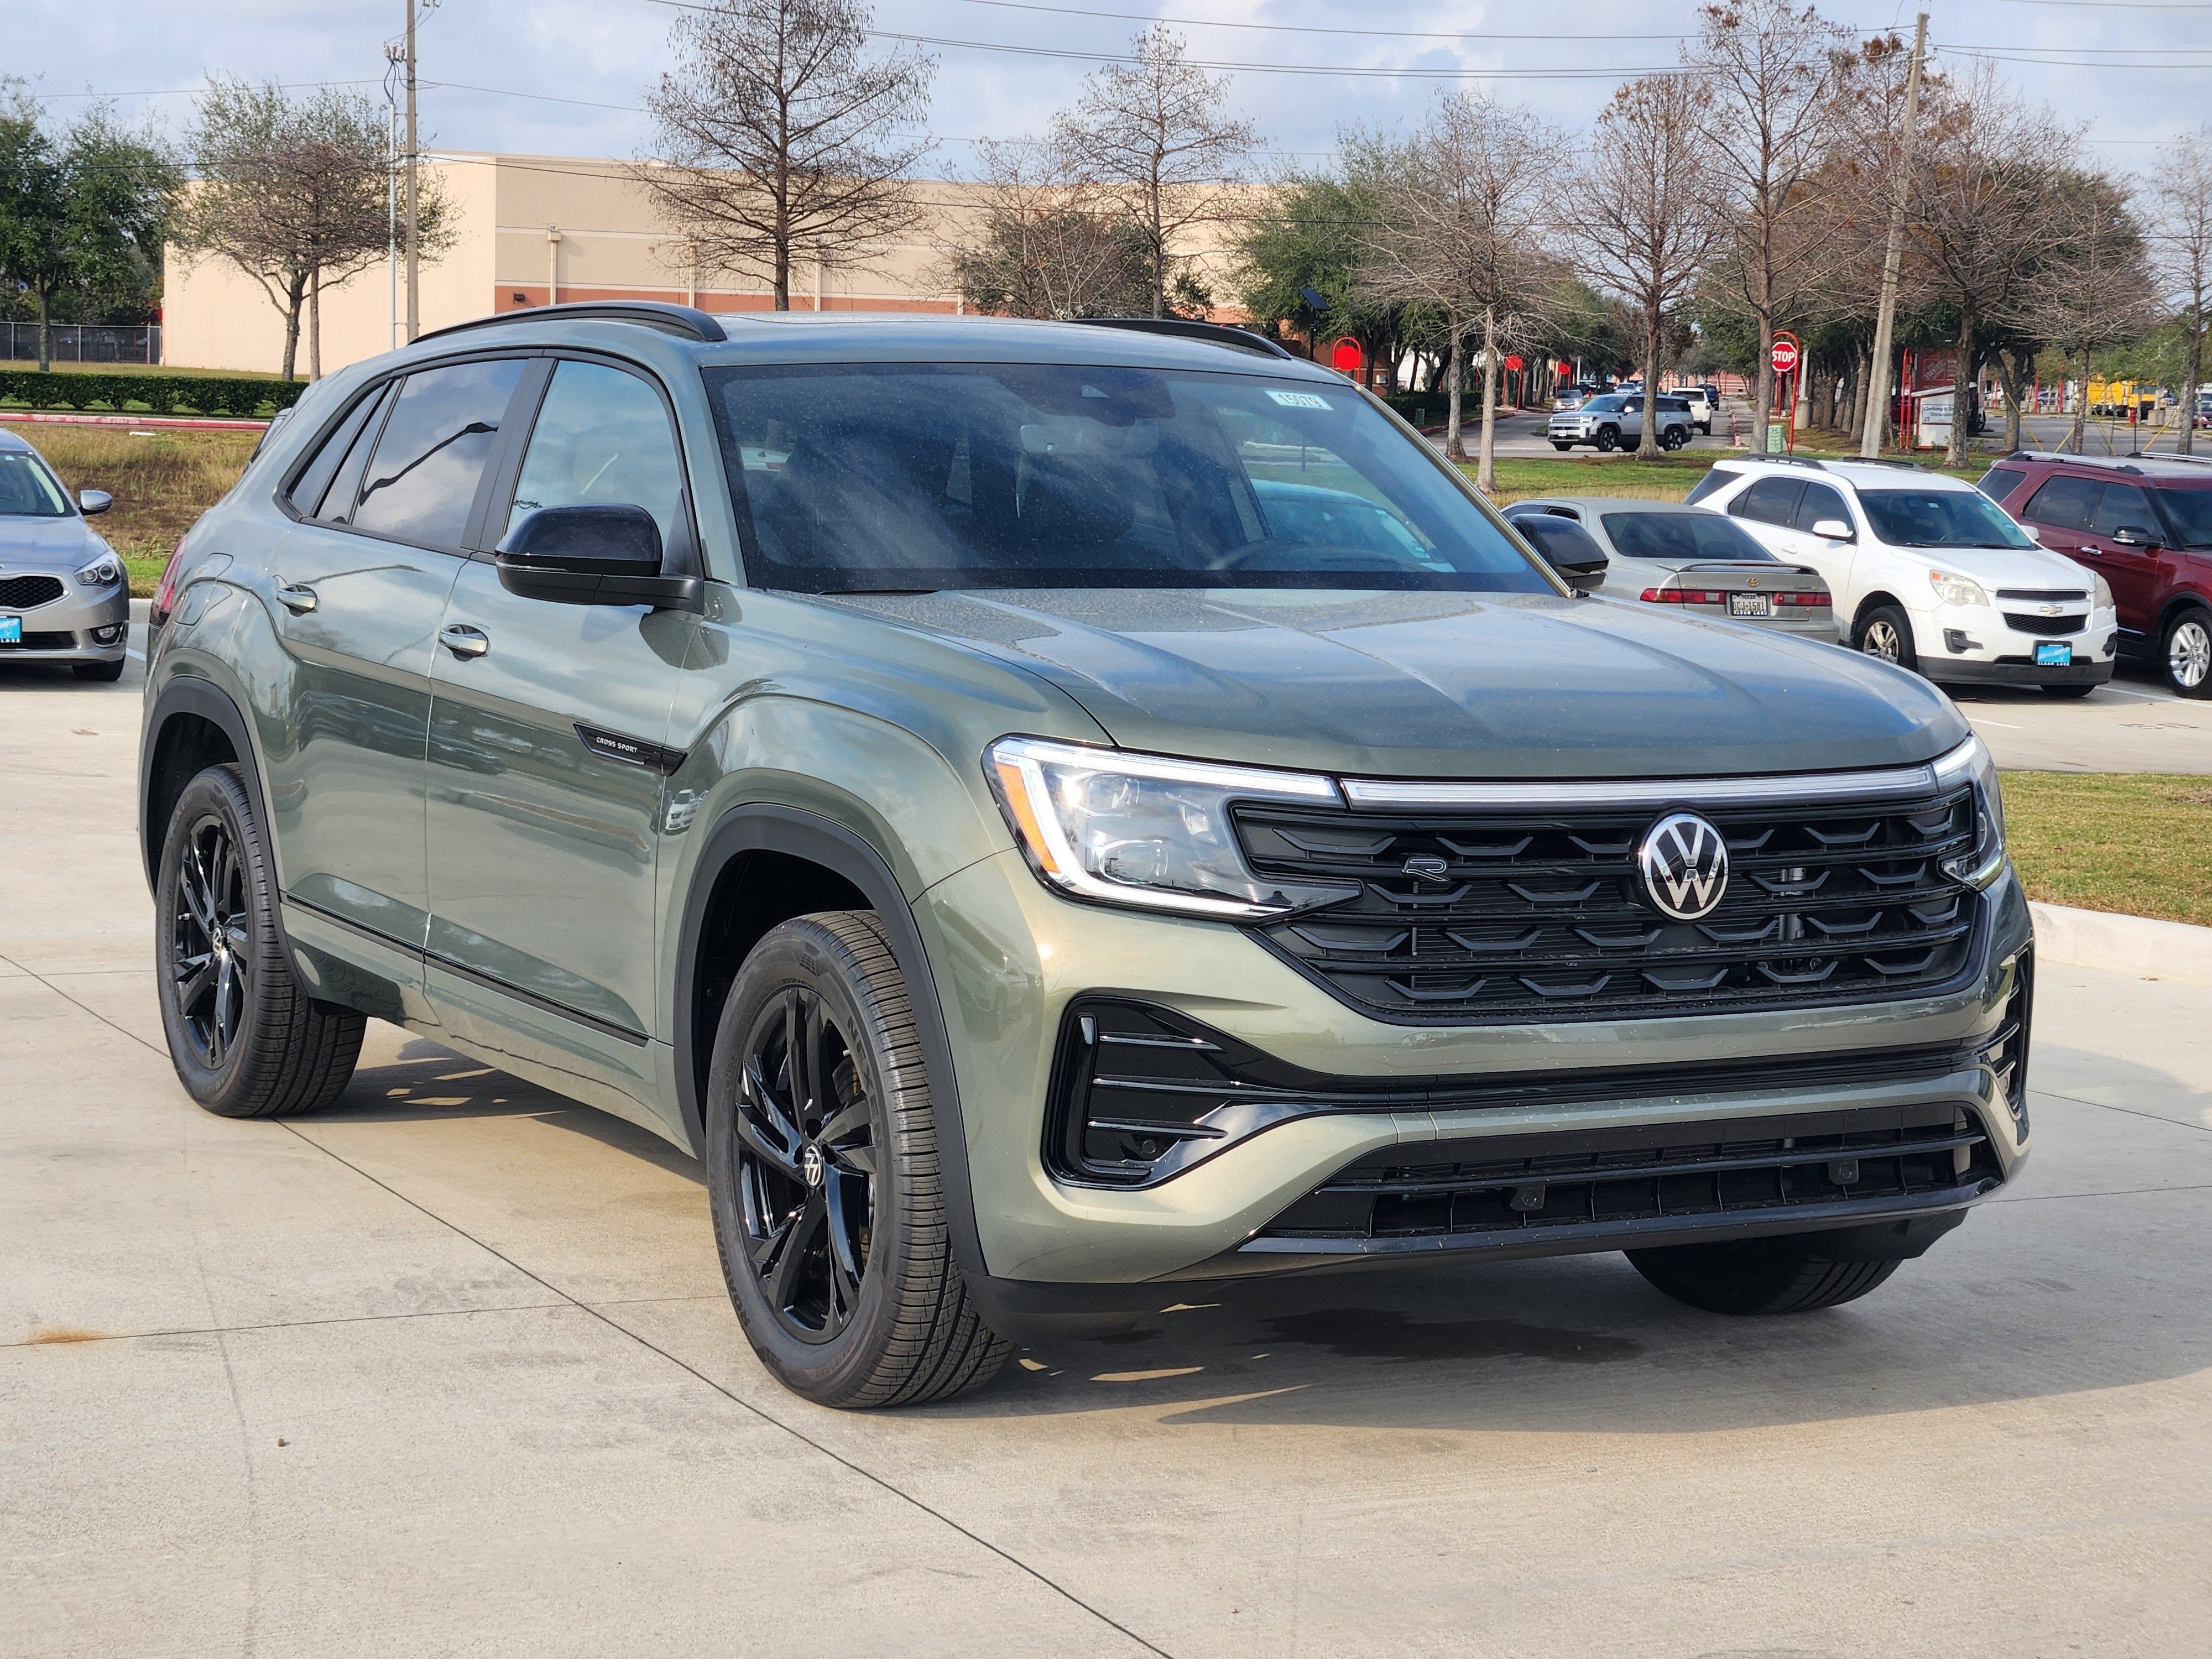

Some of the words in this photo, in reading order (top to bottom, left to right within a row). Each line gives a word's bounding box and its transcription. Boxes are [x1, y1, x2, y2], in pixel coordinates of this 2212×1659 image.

[1772, 350, 1795, 362] STOP
[1278, 393, 1322, 408] 15079
[597, 737, 616, 748] CROSS
[618, 743, 638, 753] SPORT
[1645, 817, 1727, 916] VW
[846, 1014, 883, 1150] NEXEN
[712, 1207, 750, 1329] ROADIAN
